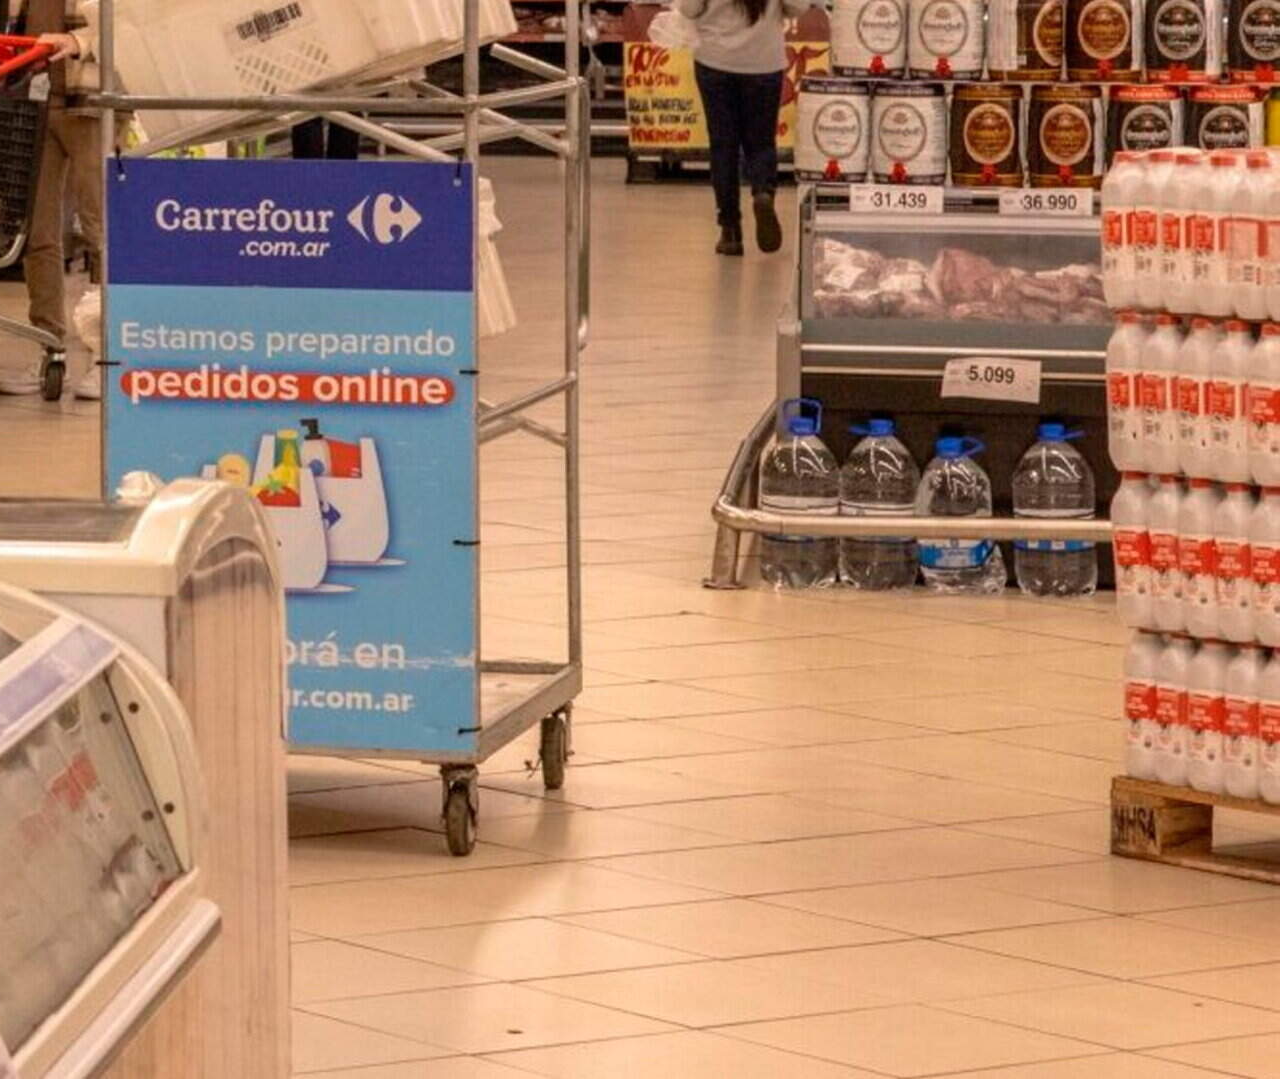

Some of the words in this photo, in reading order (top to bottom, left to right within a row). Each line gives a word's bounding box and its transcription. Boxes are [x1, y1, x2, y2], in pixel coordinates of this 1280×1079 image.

[155, 199, 335, 233] Carrefour
[239, 239, 331, 258] .com.ar
[120, 321, 255, 353] Estamos
[265, 329, 456, 359] preparando
[130, 363, 300, 405] pedidos
[312, 367, 448, 405] online
[354, 641, 406, 669] en
